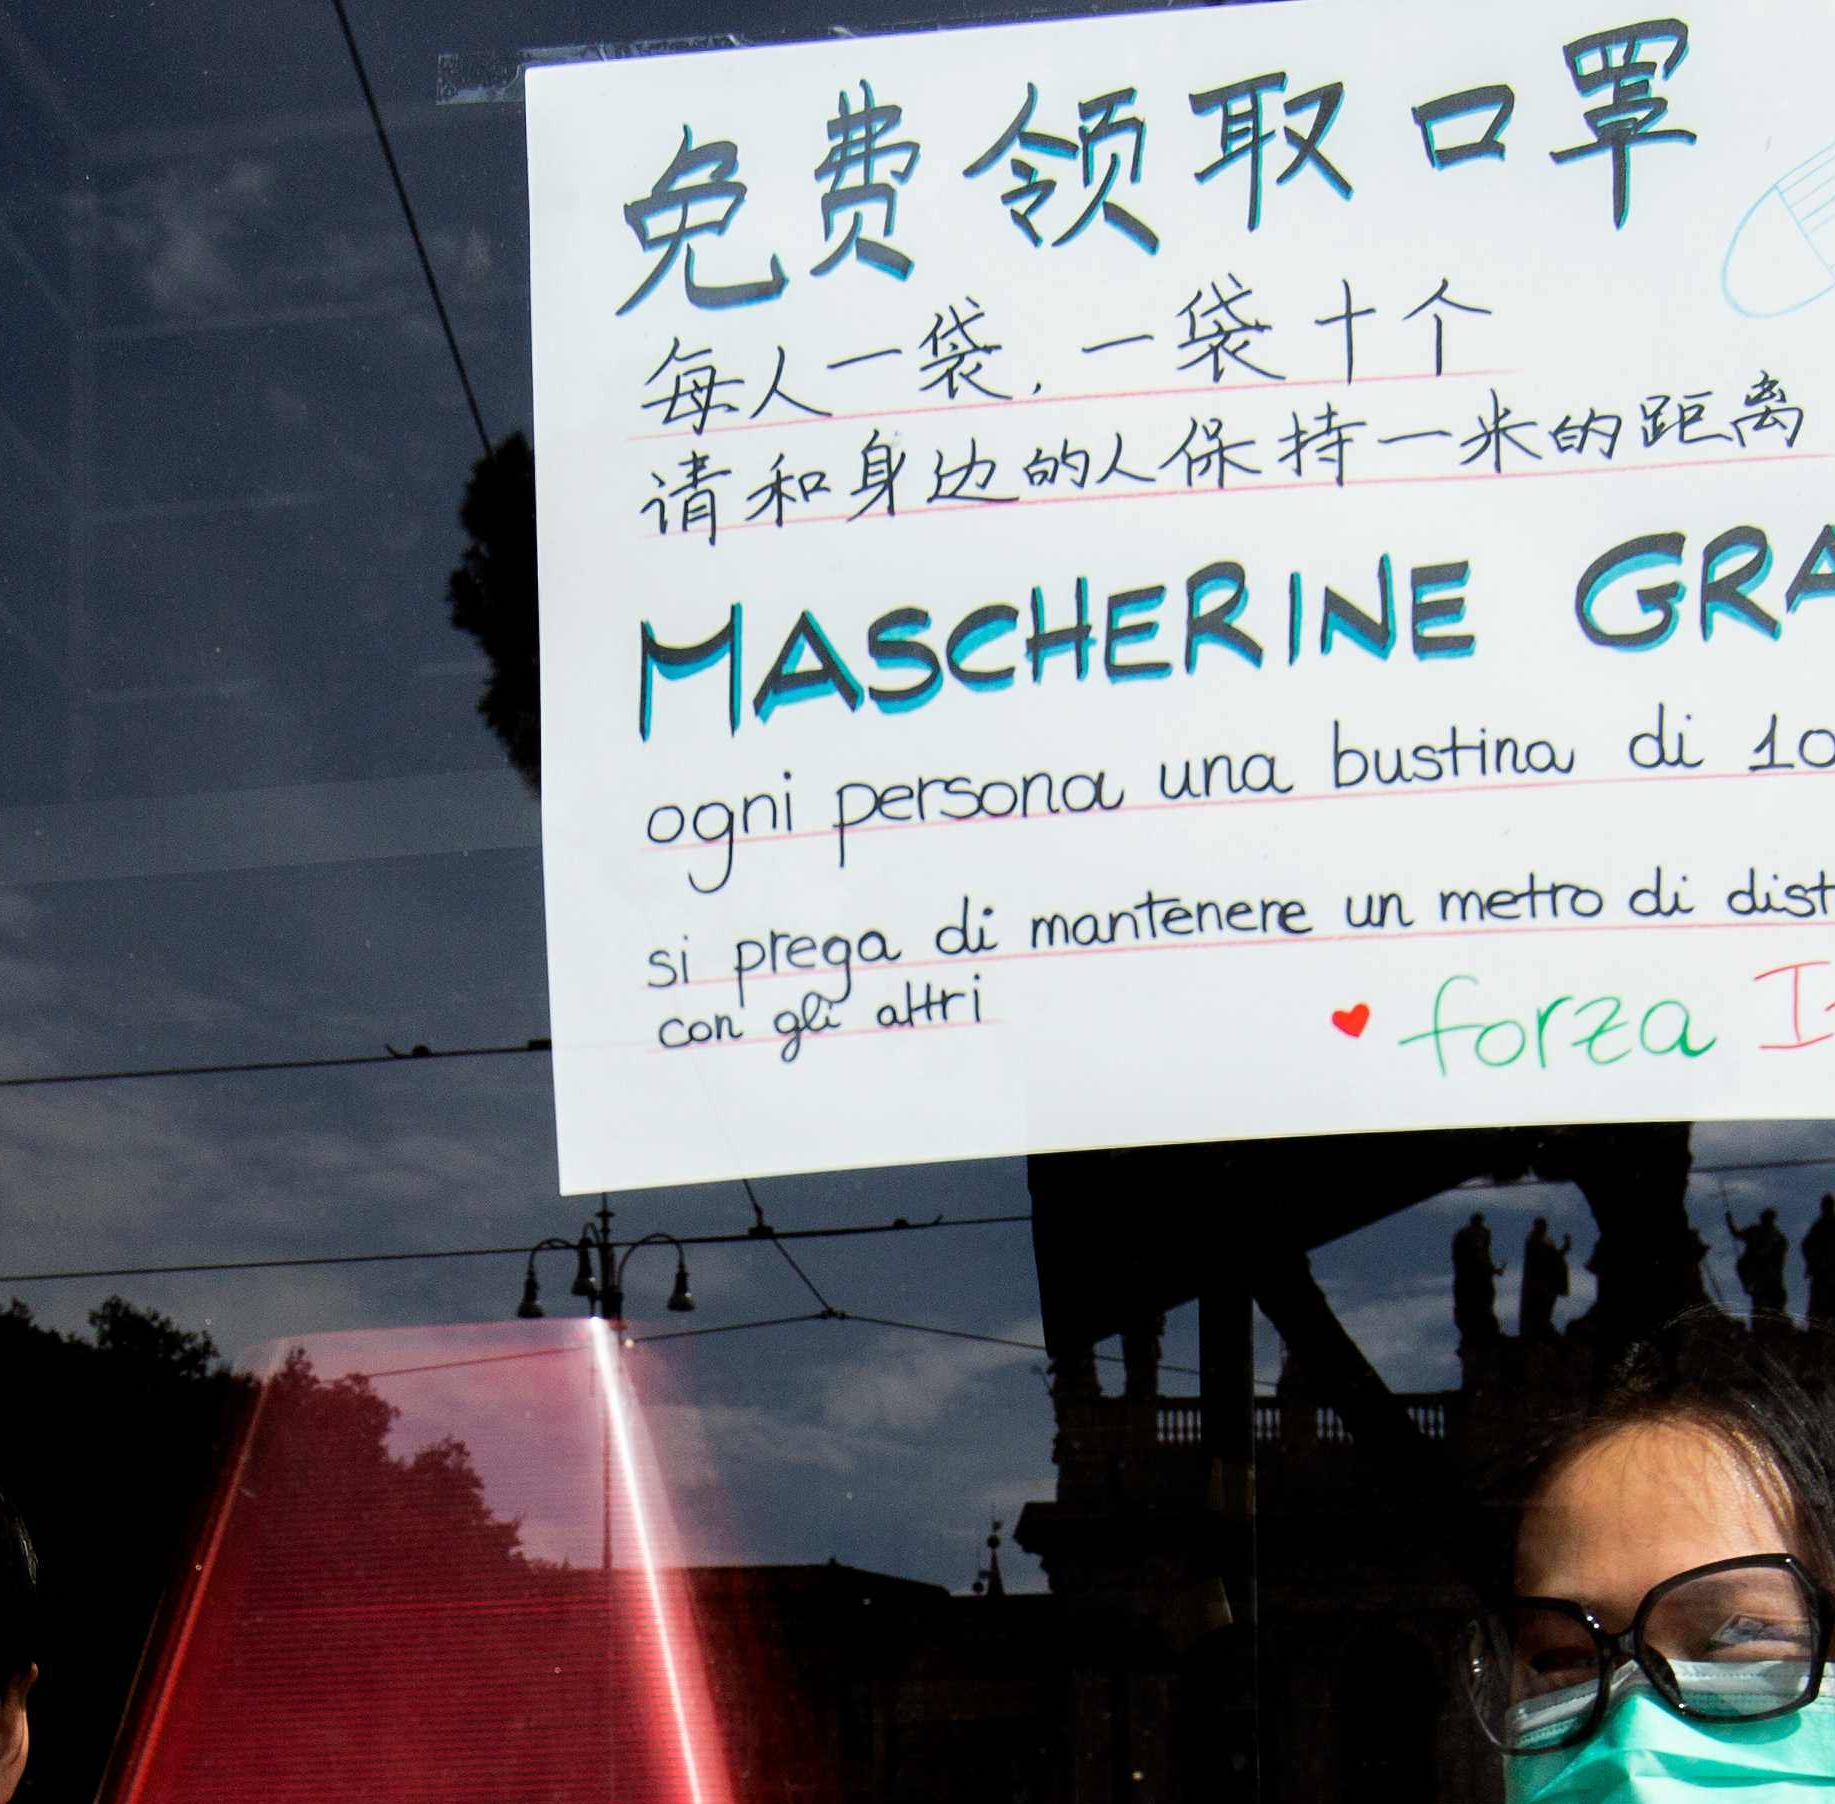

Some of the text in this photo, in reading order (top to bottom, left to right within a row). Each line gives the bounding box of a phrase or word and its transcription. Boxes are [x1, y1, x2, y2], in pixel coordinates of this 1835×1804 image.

[616, 19, 1697, 316] 免费领取口罩
[639, 371, 1806, 546] 请和身边的人保持一米的距离
[639, 552, 1477, 741] MASCHERINE
[646, 771, 795, 893] ogni
[831, 767, 1124, 867] persona
[1159, 742, 1293, 800] una
[1332, 720, 1575, 786] bustina
[1629, 703, 1704, 770] di
[647, 930, 690, 988] si
[735, 926, 902, 1007] prega
[935, 896, 999, 957] di
[1031, 890, 1314, 949] mantenere
[1346, 890, 1413, 931] un
[1439, 872, 1604, 922] metro
[1629, 865, 1693, 917] di
[657, 973, 983, 1062] con gli altri
[1399, 974, 1717, 1076] forza
